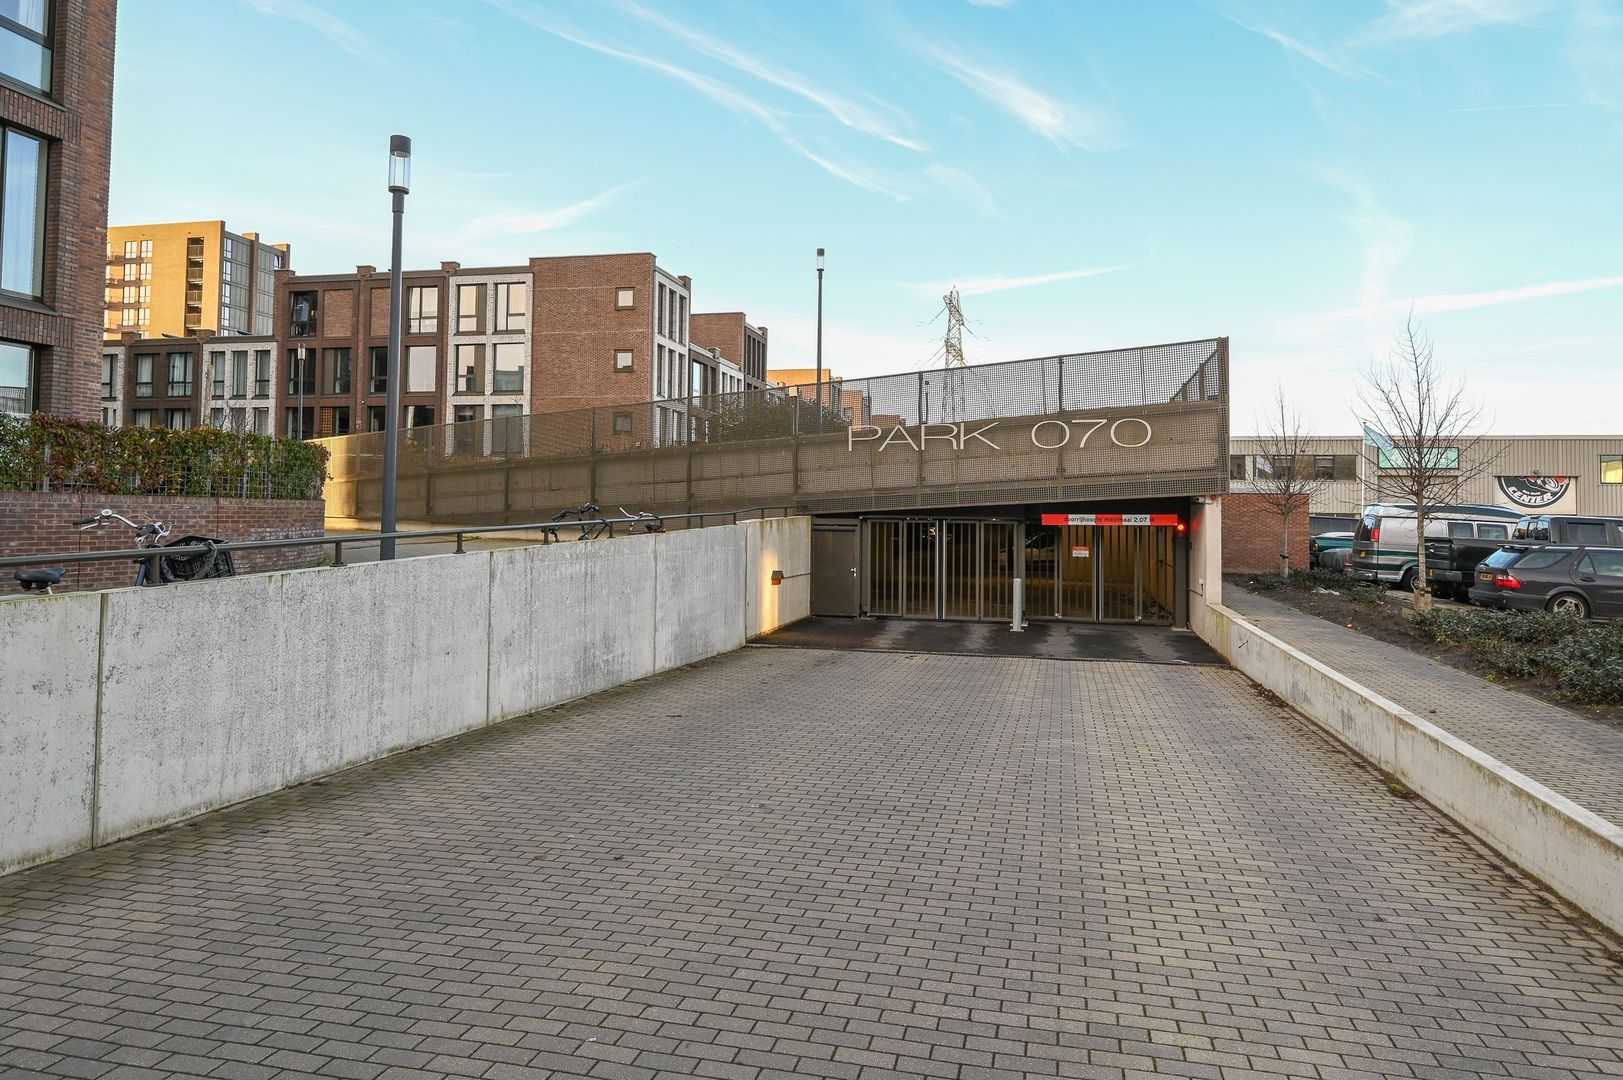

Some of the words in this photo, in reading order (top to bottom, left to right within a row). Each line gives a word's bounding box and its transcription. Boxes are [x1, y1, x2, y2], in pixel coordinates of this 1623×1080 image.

[848, 422, 1000, 451] PARK
[1031, 418, 1152, 449] 070
[1508, 487, 1553, 503] CENTER
